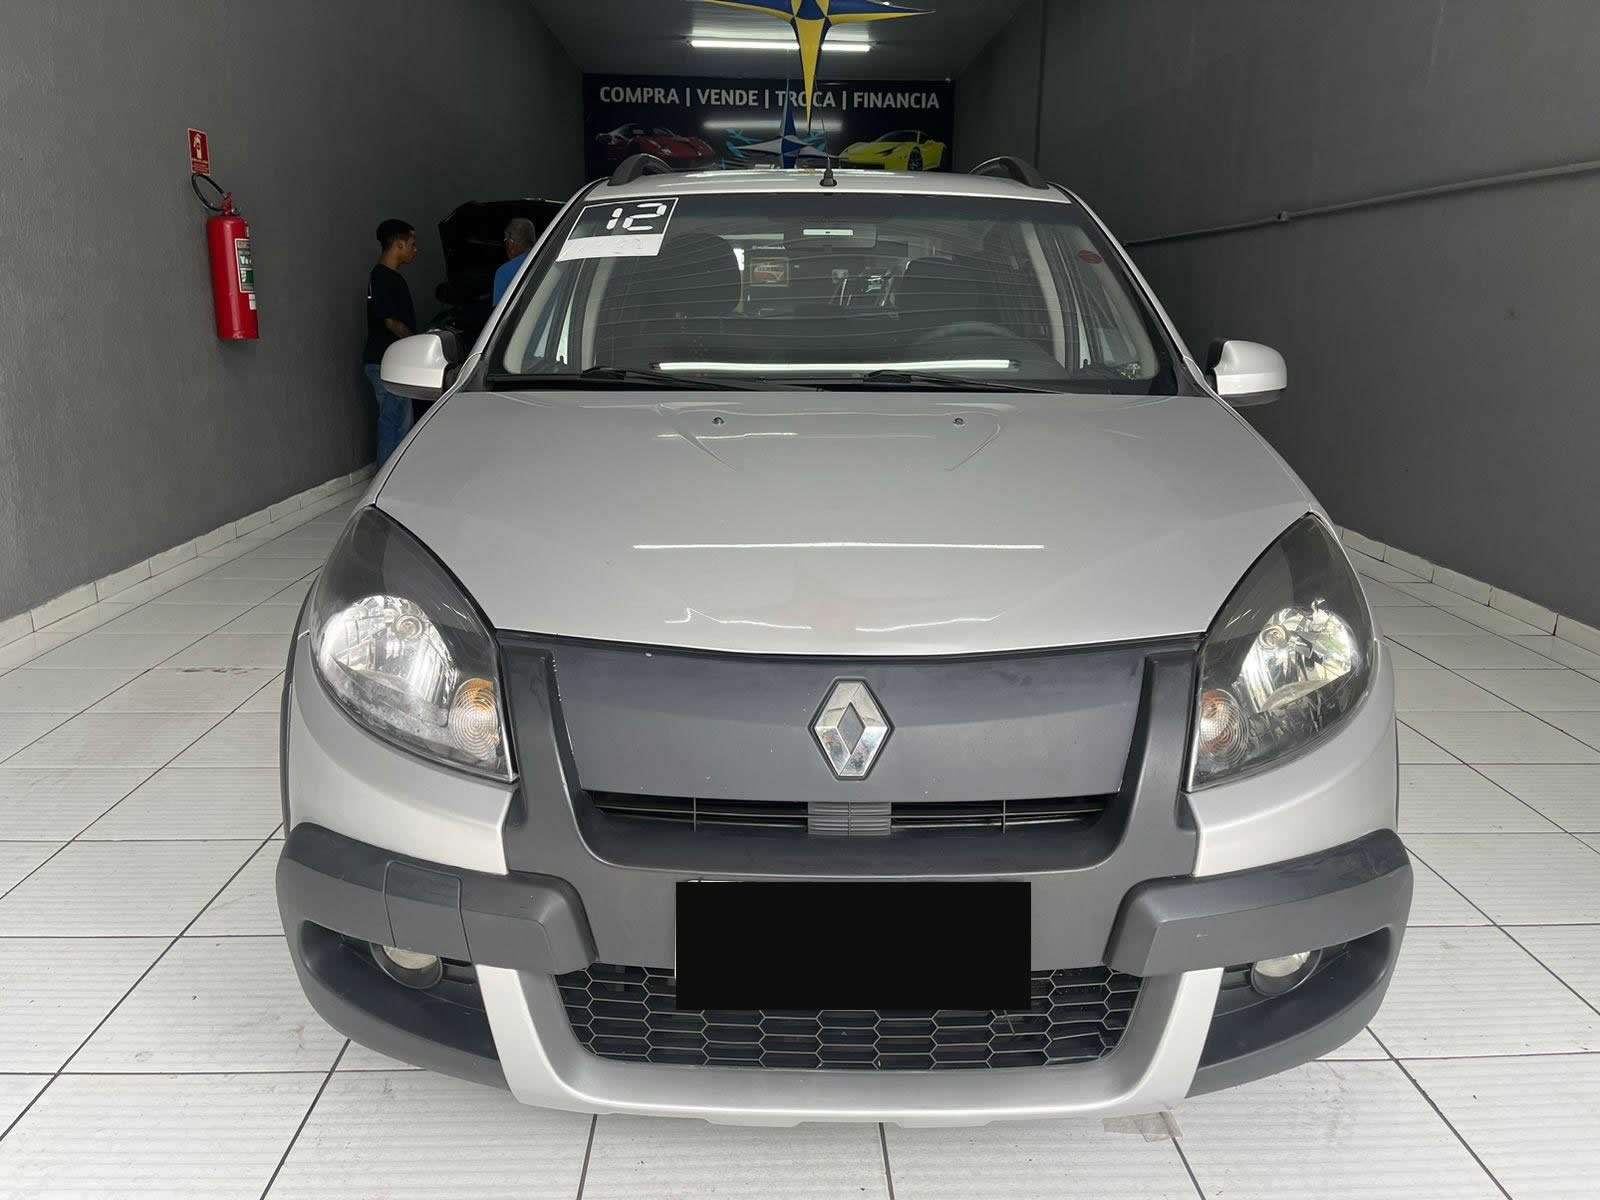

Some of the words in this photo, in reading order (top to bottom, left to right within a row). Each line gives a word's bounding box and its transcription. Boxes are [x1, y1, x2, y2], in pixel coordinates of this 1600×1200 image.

[600, 86, 680, 104] COMPRA
[697, 88, 759, 106] VENDE
[775, 90, 836, 108] TROCA
[853, 91, 940, 109] FINANCIA
[606, 202, 667, 231] 12
